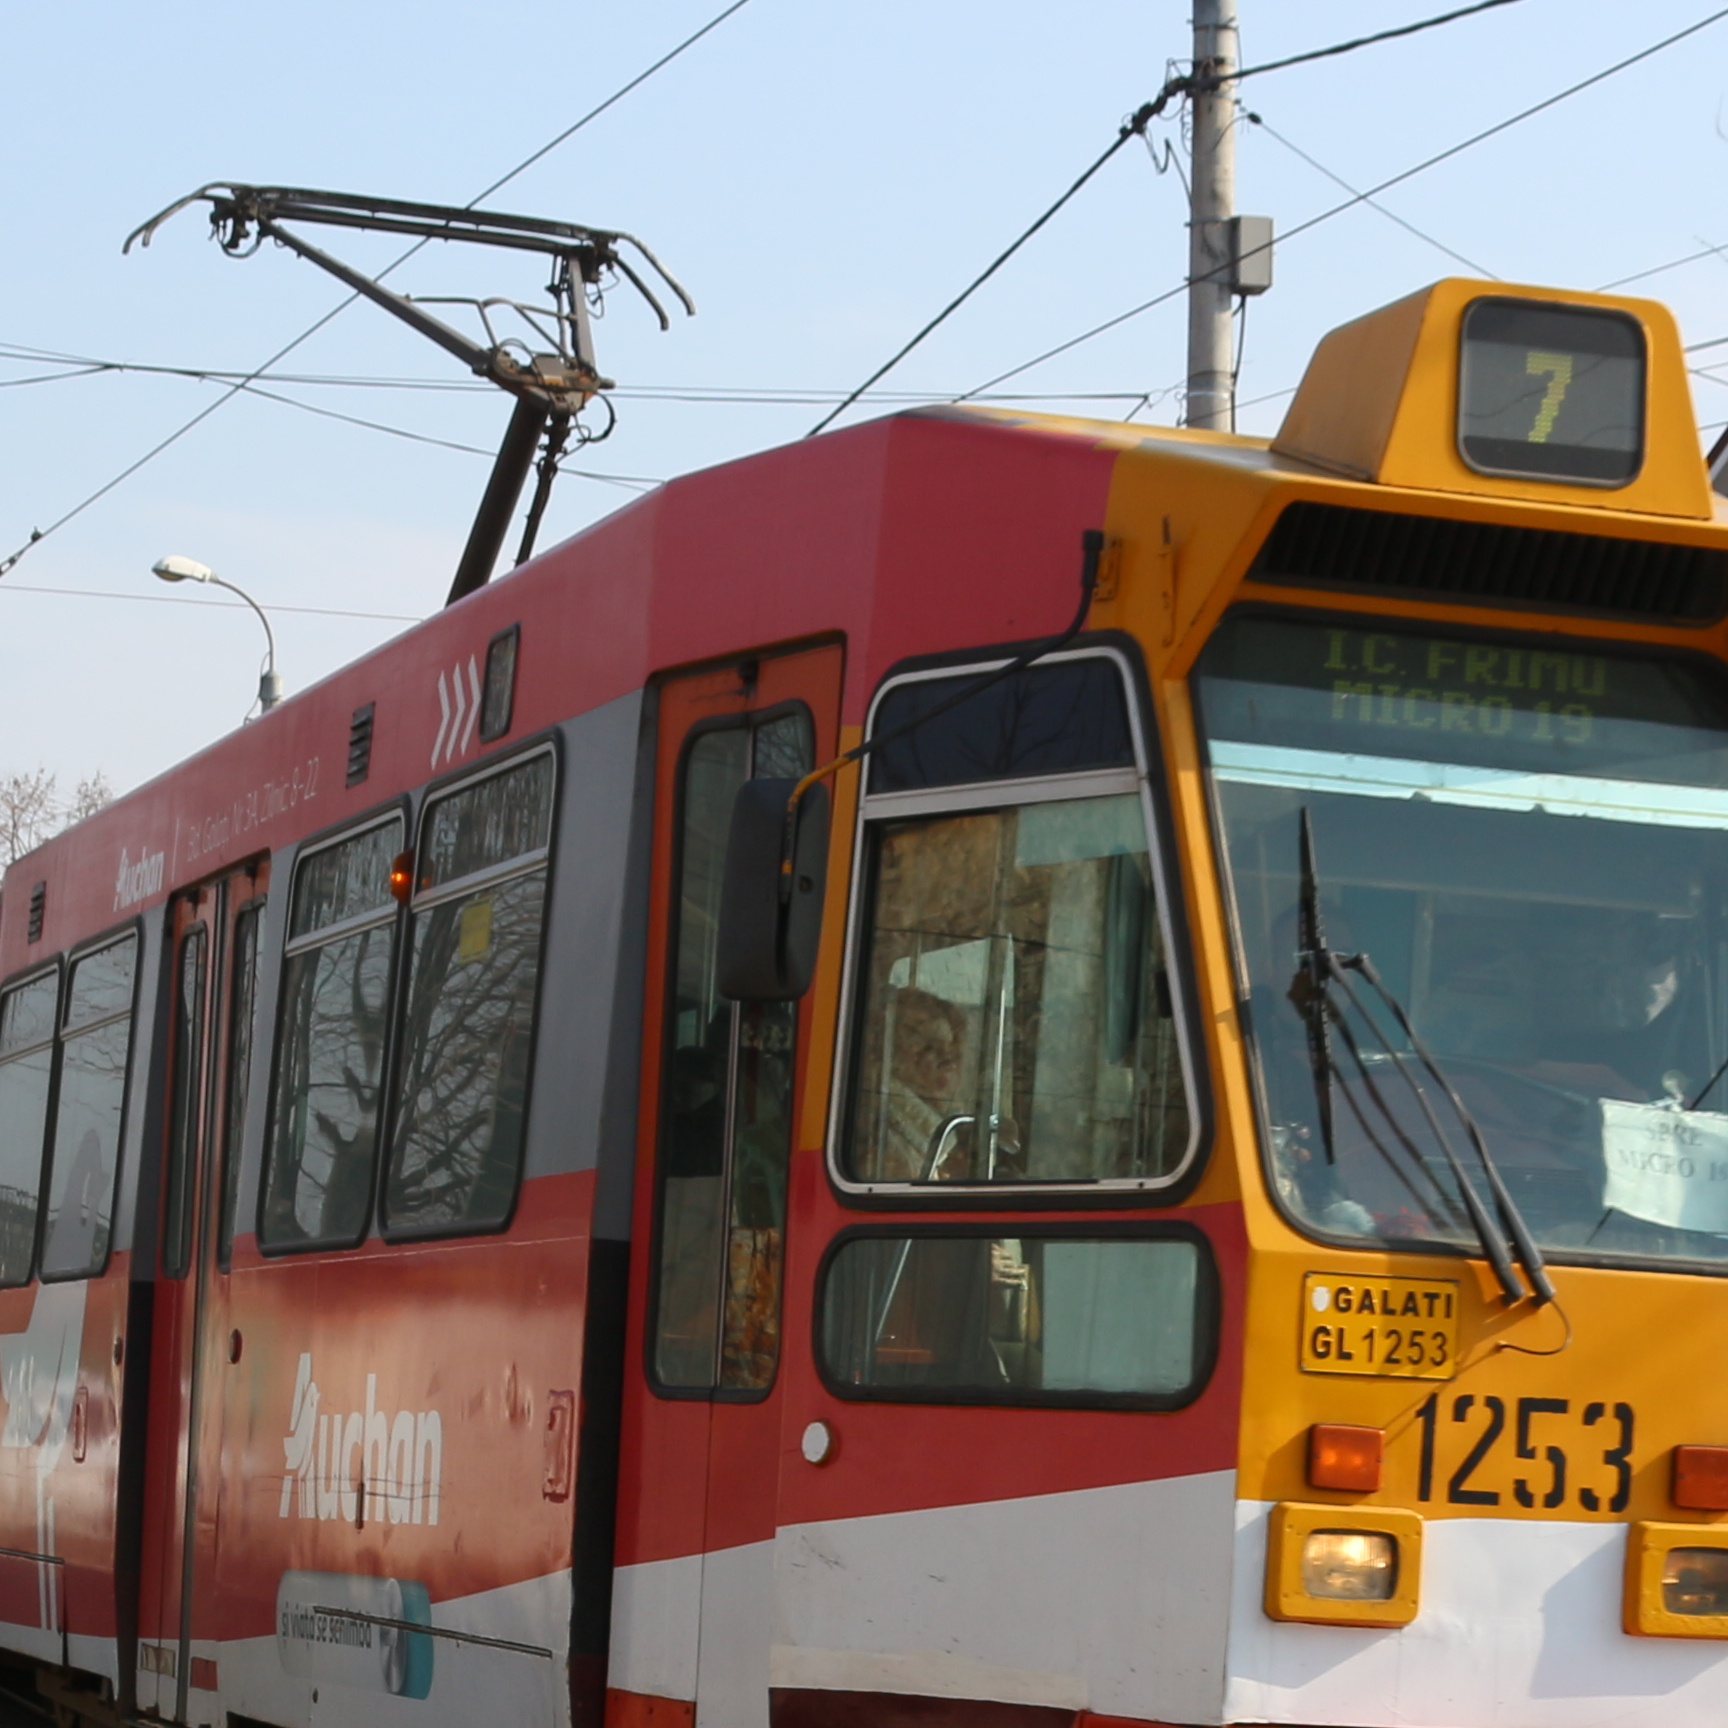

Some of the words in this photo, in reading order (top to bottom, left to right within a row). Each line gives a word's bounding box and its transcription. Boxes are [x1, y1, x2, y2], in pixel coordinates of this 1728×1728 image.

[1525, 351, 1574, 445] 7
[1322, 630, 1408, 675] I.C.
[1426, 640, 1608, 697] FRIMU
[1331, 678, 1514, 737] MICRO
[1530, 699, 1594, 744] 19
[113, 846, 166, 913] Auchan
[1334, 1285, 1453, 1319] GALATI
[278, 1351, 444, 1527] Auchan
[1415, 1391, 1635, 1513] 1253
